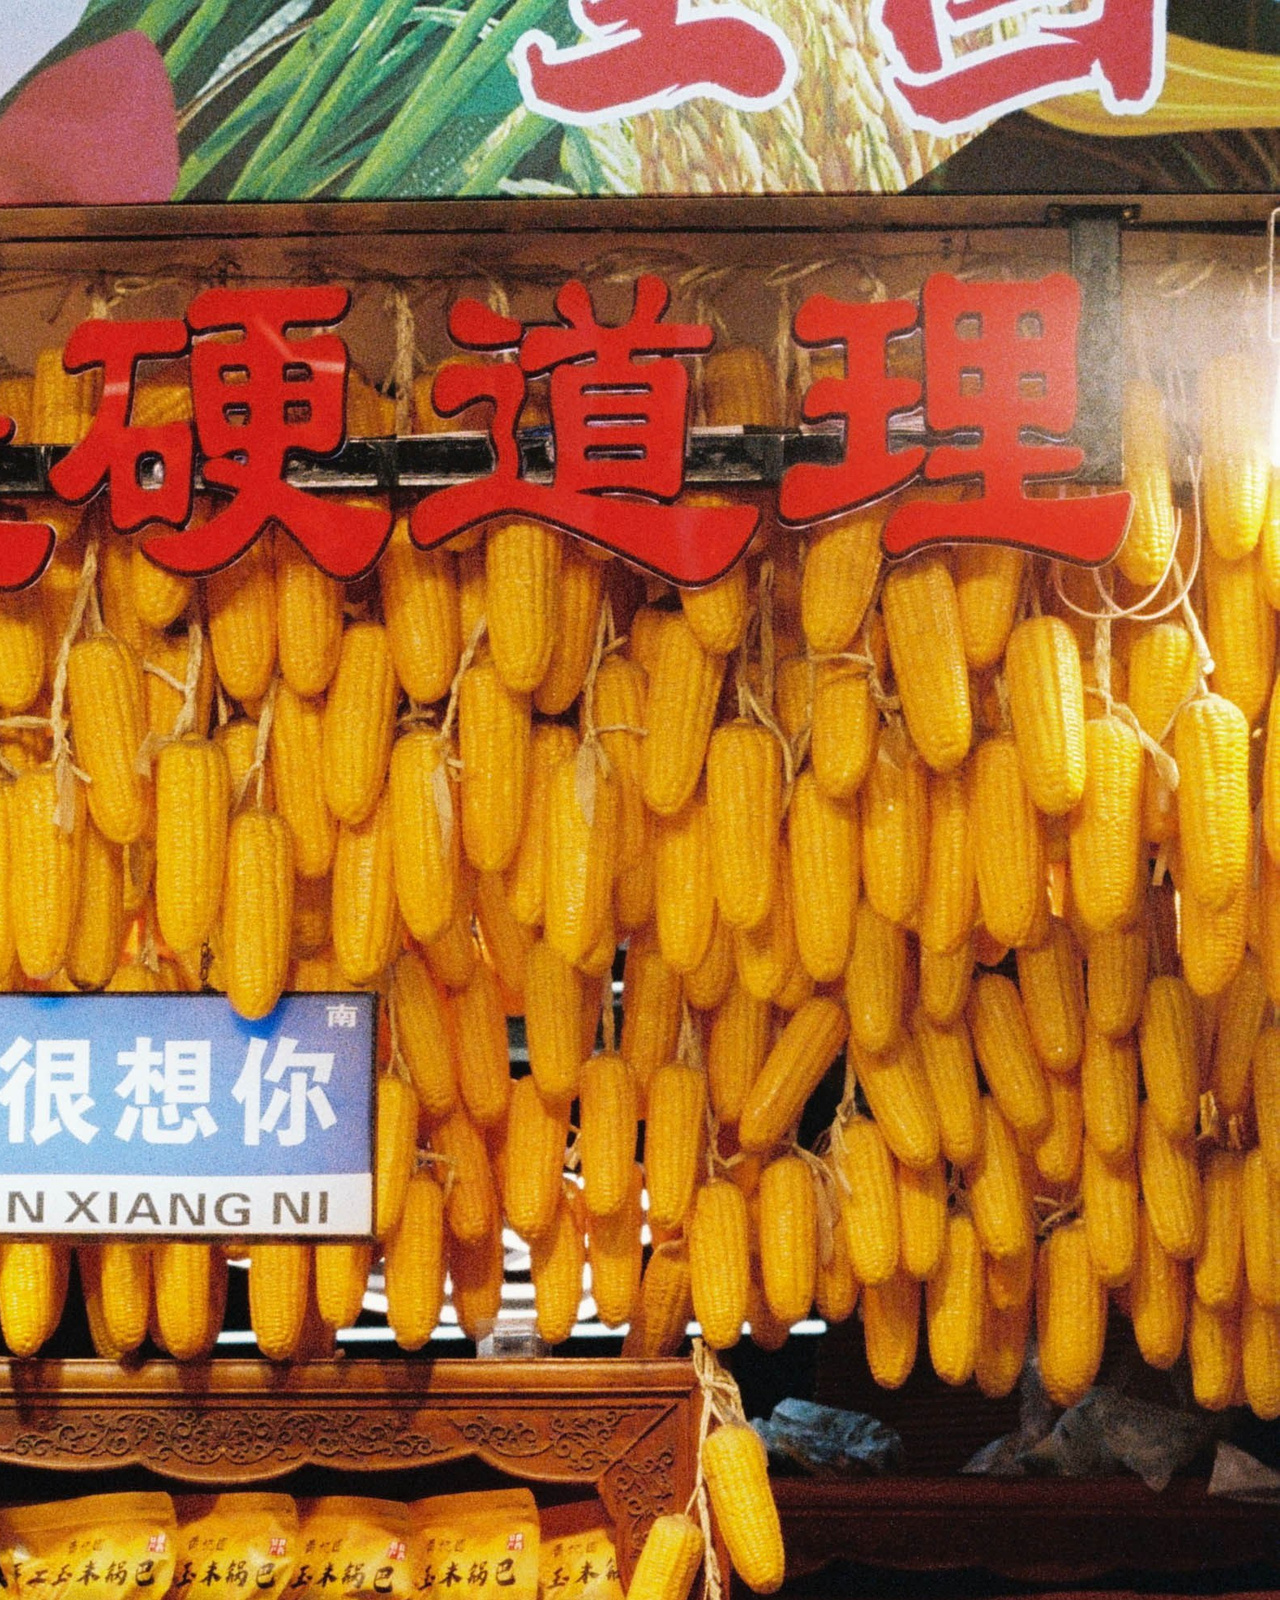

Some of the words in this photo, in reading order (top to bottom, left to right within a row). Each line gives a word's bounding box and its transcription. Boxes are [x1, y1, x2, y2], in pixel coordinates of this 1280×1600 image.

[327, 1003, 358, 1028] 南
[65, 1190, 252, 1227] XIANG
[272, 1190, 330, 1226] NI
